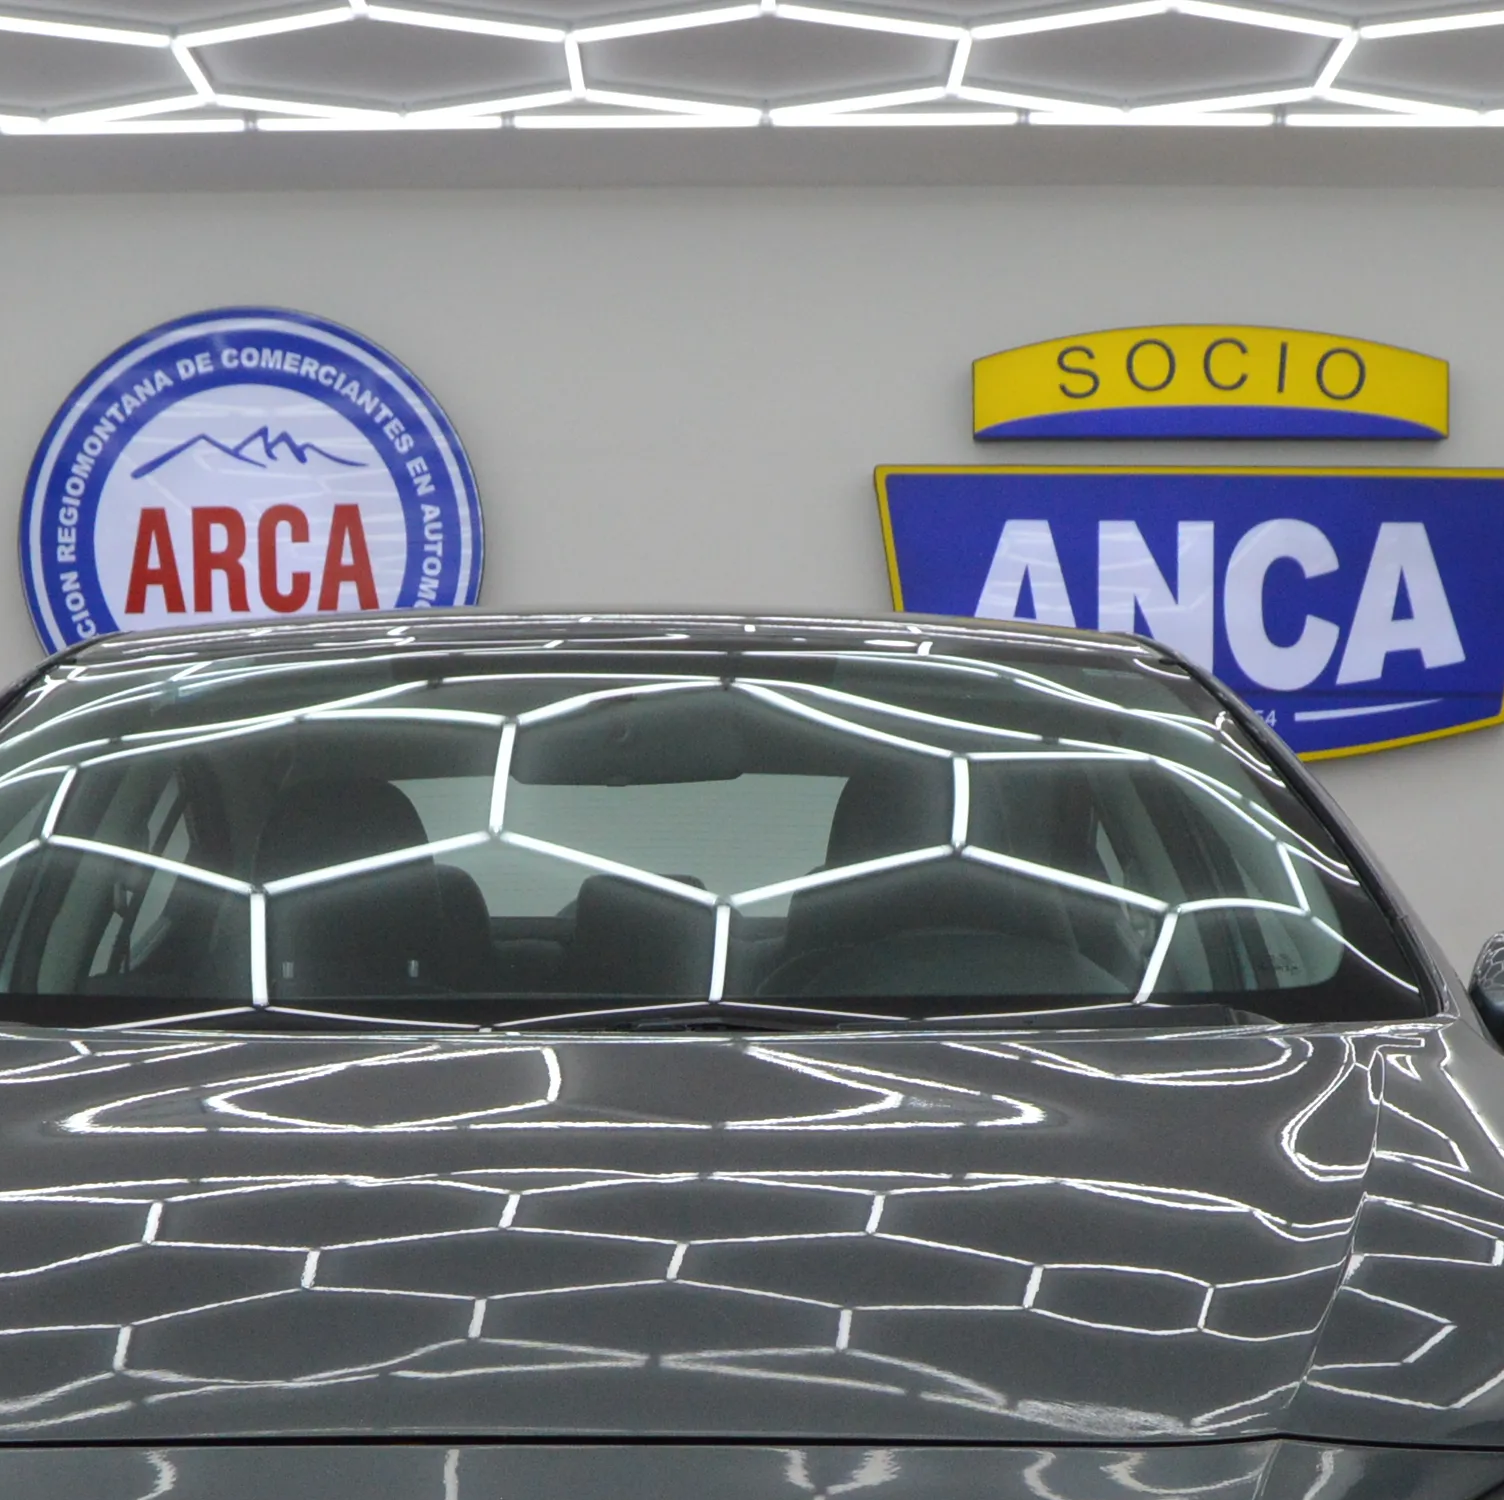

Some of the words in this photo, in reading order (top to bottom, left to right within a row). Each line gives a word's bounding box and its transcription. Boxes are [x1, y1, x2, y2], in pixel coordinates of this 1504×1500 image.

[1057, 337, 1367, 399] SOCIO
[56, 369, 174, 563] REGIOMONTANA
[177, 352, 214, 379] DE
[221, 347, 413, 455] COMERCIANTES
[405, 456, 435, 496] EN
[124, 503, 381, 615] ARCA
[974, 518, 1466, 691] ANCA
